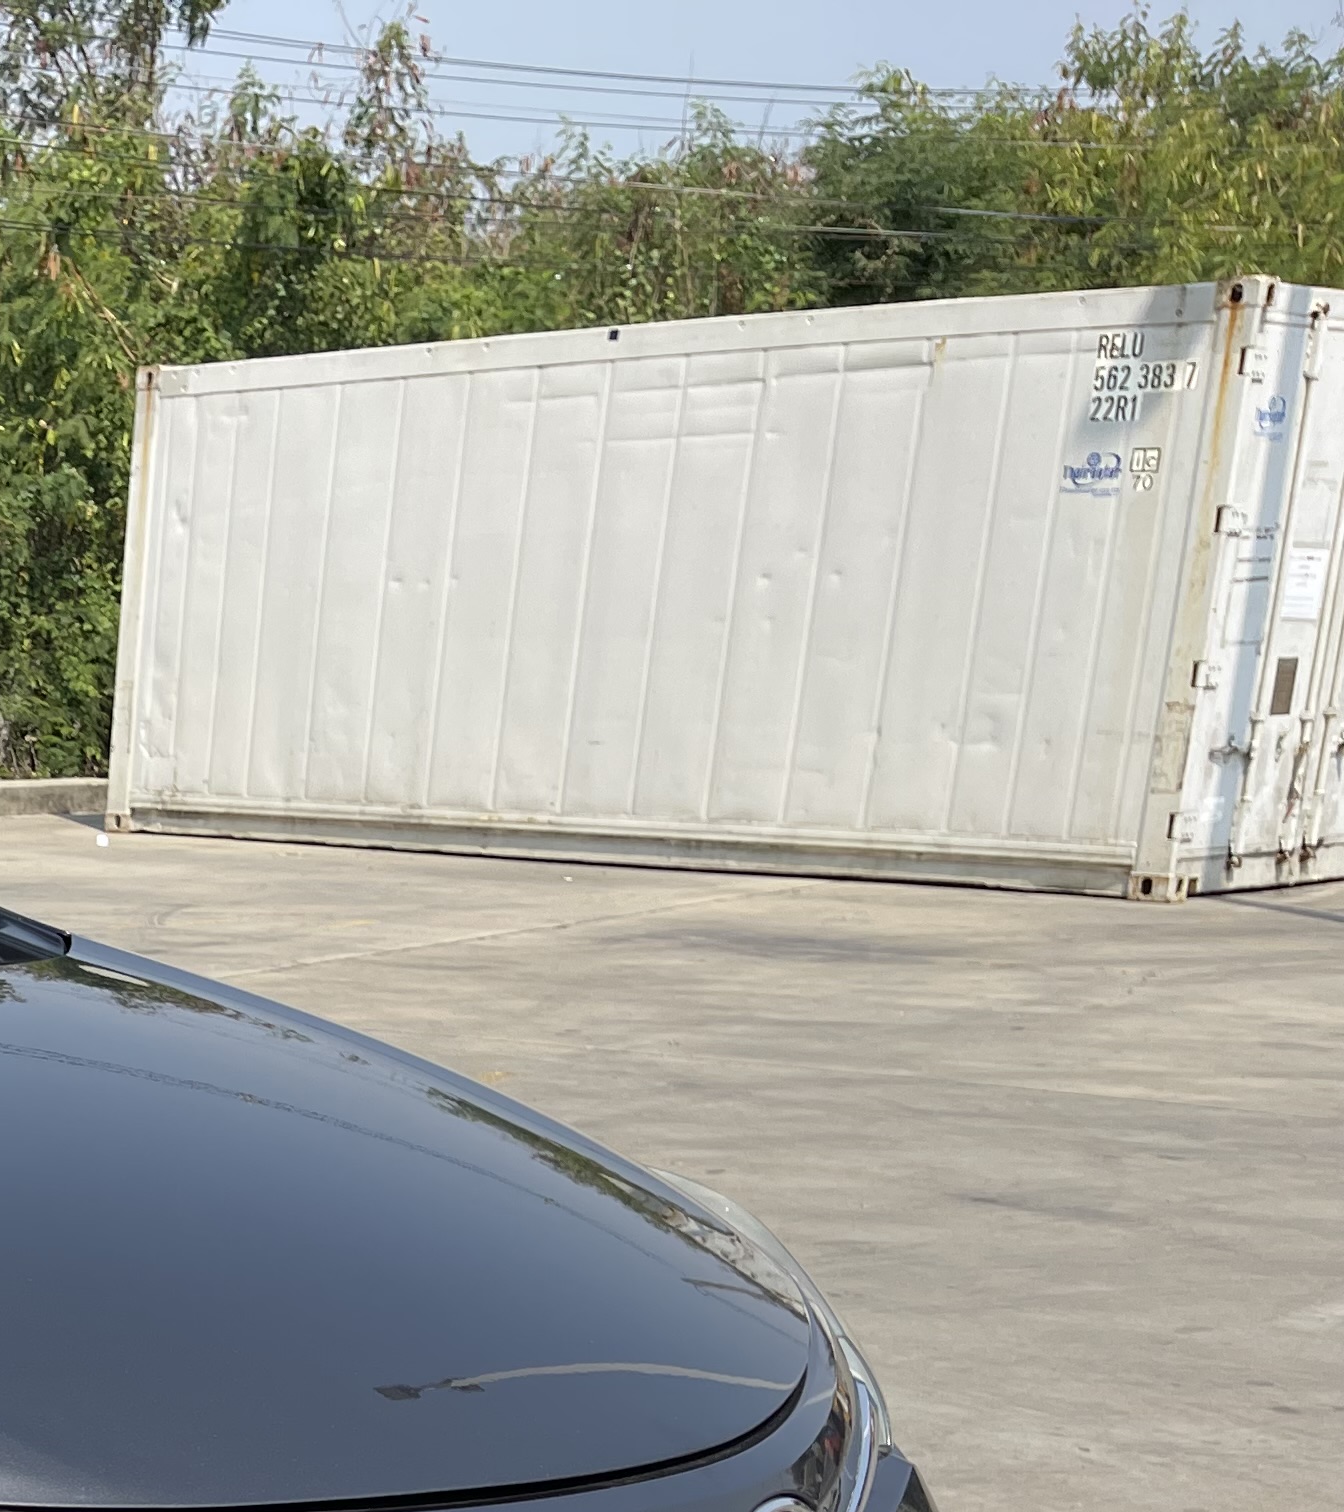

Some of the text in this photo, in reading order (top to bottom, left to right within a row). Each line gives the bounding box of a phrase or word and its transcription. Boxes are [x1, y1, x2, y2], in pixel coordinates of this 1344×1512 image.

[1097, 332, 1144, 359] RELU
[1093, 361, 1197, 391] 562 383 7
[1090, 395, 1137, 422] 22R1
